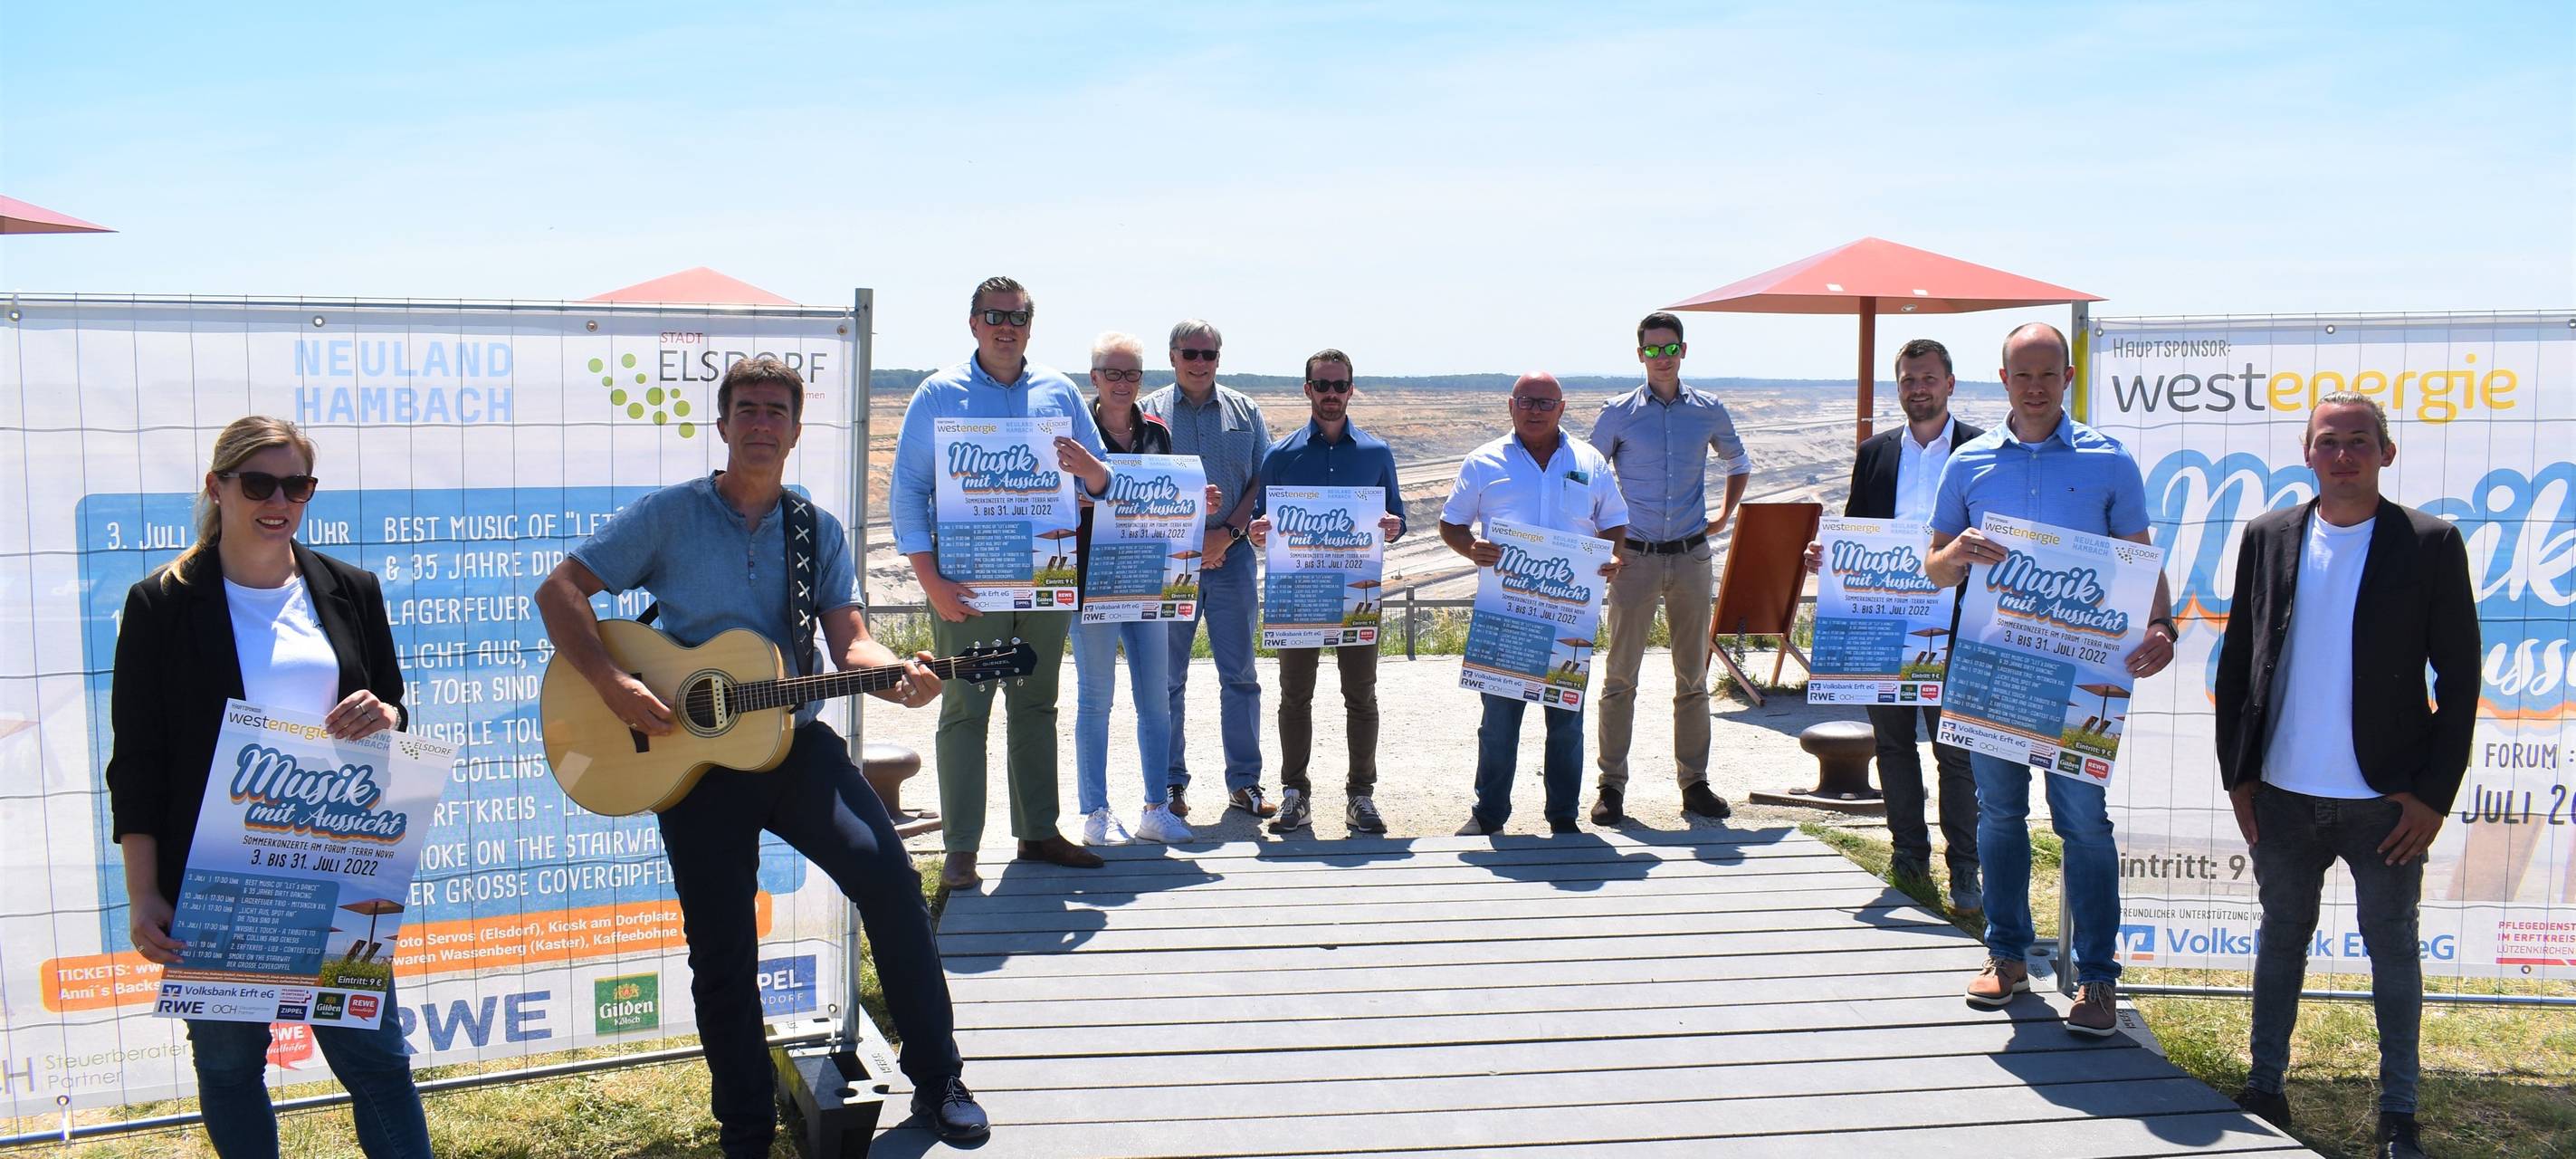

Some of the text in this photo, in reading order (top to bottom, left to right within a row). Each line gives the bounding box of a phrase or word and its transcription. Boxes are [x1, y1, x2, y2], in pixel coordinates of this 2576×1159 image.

[661, 332, 702, 343] STADT
[295, 340, 511, 377] NEULAND
[2113, 339, 2231, 359] HAUPTSPONSOR:
[295, 388, 512, 423] HAMBACH
[937, 424, 997, 434] westenergie
[950, 443, 1035, 474] Musik
[965, 473, 1057, 490] mit Aussicht
[1109, 474, 1178, 502] Musik
[1268, 490, 1320, 500] westenergie
[973, 504, 1053, 516] 3. BIS 31. JULI 2022
[1117, 501, 1194, 516] mit Aussicht
[384, 513, 558, 542] BEST MUSIC OF
[1279, 506, 1352, 534] Musik
[1822, 523, 1880, 533] westenergie
[107, 520, 350, 550] 3. JULI UHR
[1290, 532, 1370, 547] mit Aussicht
[1492, 526, 1544, 542] westenergie
[1985, 522, 2061, 545] westenergie
[2074, 535, 2111, 550] NEULAND
[1835, 542, 1918, 574] Musik
[2072, 542, 2109, 557] HAMBACH
[2127, 547, 2159, 560] ELSDORF
[386, 556, 399, 580] &
[411, 553, 438, 580] 35
[448, 551, 522, 580] JAHRE
[1328, 560, 1363, 569] JULI 2022
[1496, 546, 1572, 582] Musik
[1505, 577, 1589, 600] mit Aussicht
[1846, 572, 1937, 589] mit Aussich
[1990, 552, 2102, 604] Musik
[386, 596, 530, 626] LAGERFEUER
[1083, 613, 1106, 621] RWE
[1541, 609, 1578, 625] JULI 2022
[1889, 605, 1930, 616] JULI 2022
[2001, 595, 2124, 632] mit Aussicht
[399, 642, 467, 670] LICHT
[478, 639, 528, 669] AUS,
[2004, 630, 2108, 666] 3. BIS 31. JULI 2022
[405, 676, 539, 706] IE 70ER SIND
[1461, 677, 1484, 689] RWE
[1810, 693, 1836, 701] RWE
[230, 712, 328, 740] westenergie
[1958, 724, 2027, 748] Volksbank Erft eG
[414, 742, 453, 755] ELSDORF
[1940, 731, 1975, 747] RWE
[2485, 742, 2558, 769] FORUM
[235, 747, 377, 807] Musik
[453, 753, 544, 783] COLLINS
[430, 796, 536, 827] RFTKREIS
[2462, 784, 2531, 824] JULI
[252, 802, 401, 835] mit Aussicht
[243, 835, 309, 851] SOMMERKONZERTE
[310, 842, 322, 852] AM
[324, 844, 346, 854] FORUM
[376, 850, 395, 859] NOVA
[420, 828, 666, 871] OKE ON THE STAIRWA
[251, 849, 378, 876] 3. BIS 31. JULI 2022
[2120, 853, 2246, 880] intritt: 9
[409, 861, 676, 906] ER GROSSE COVERGIPFEL
[2180, 908, 2249, 921] UNTERSTÜTZUNG
[397, 910, 678, 949] oto Servos (Elsdorf), Kiosk am Dorfplatz
[2498, 933, 2576, 943] IM ERFTKREIS
[441, 943, 526, 963] Wassenberg
[530, 935, 589, 957] (Kaster),
[593, 926, 678, 946] Kaffeebohne
[58, 963, 130, 982] TICKETS:
[338, 975, 368, 985] Eintritt:
[757, 969, 803, 991] PEL
[185, 985, 237, 998] Volksbank
[239, 989, 259, 998] Erft
[261, 990, 275, 999] eG
[352, 999, 376, 1007] REWE
[157, 1000, 205, 1014] RWE
[212, 1004, 237, 1014] OCH
[317, 1003, 341, 1012] Gilden
[599, 1001, 654, 1019] Gilden
[45, 1042, 188, 1071] Steuerberater
[48, 1068, 124, 1090] Partner
